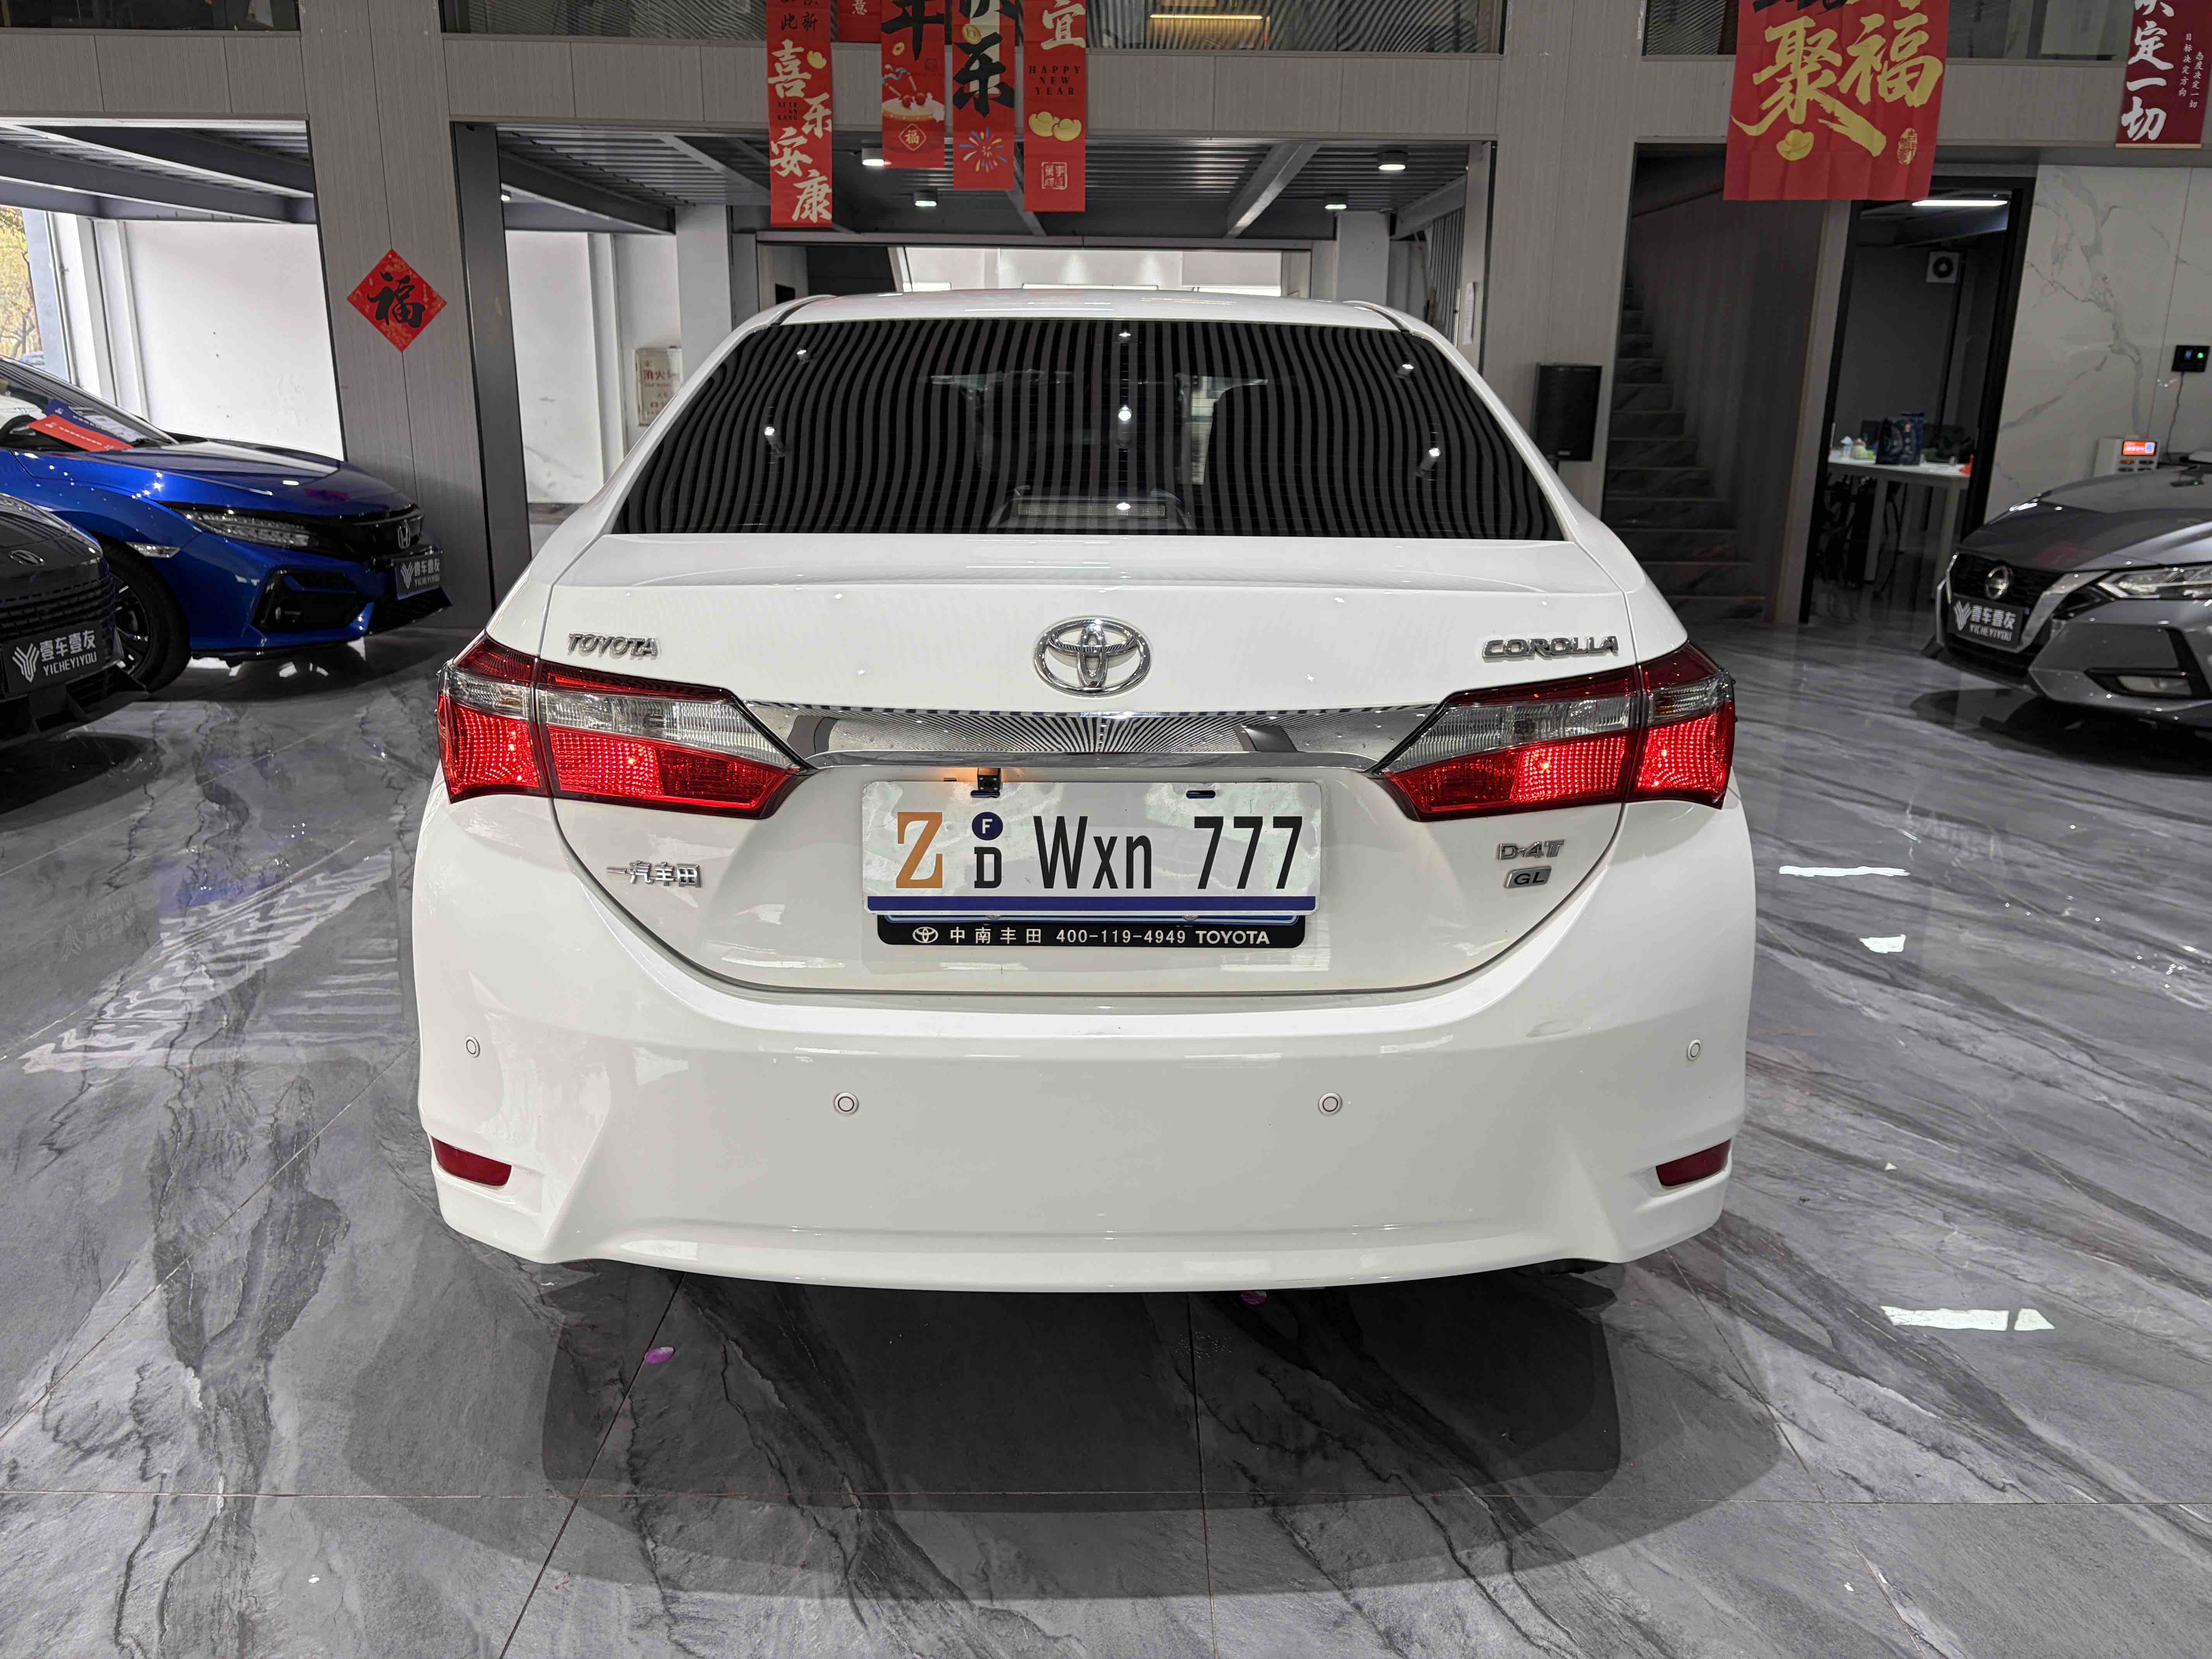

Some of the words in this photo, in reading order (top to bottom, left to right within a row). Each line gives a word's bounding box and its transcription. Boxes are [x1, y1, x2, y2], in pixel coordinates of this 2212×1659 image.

[1041, 0, 1085, 50] 宜
[1029, 66, 1080, 74] HAPPY
[2179, 33, 2193, 96] 目标决定方向
[2189, 51, 2204, 108] 态度决定一切
[1036, 87, 1075, 95] YEAR
[1731, 12, 1943, 157] 聚福
[768, 39, 833, 223] 喜乐安康
[904, 129, 919, 144] 福
[367, 272, 426, 328] 福
[40, 630, 96, 662] 壹车壹友
[568, 633, 658, 658] TOYOTA
[1482, 635, 1619, 658] COROLLA
[43, 651, 97, 676] YICHEYIYOU
[895, 812, 943, 888] Z
[1034, 816, 1152, 890] Wxn
[1194, 816, 1303, 890] 777
[1498, 839, 1565, 860] D-4T
[607, 860, 701, 888] 一汽丰田
[974, 846, 1003, 889] D
[1514, 872, 1544, 885] GL
[950, 927, 1042, 944] 中南丰田
[1056, 929, 1186, 944] 400-119-4949
[1195, 931, 1270, 945] TOYOTA
